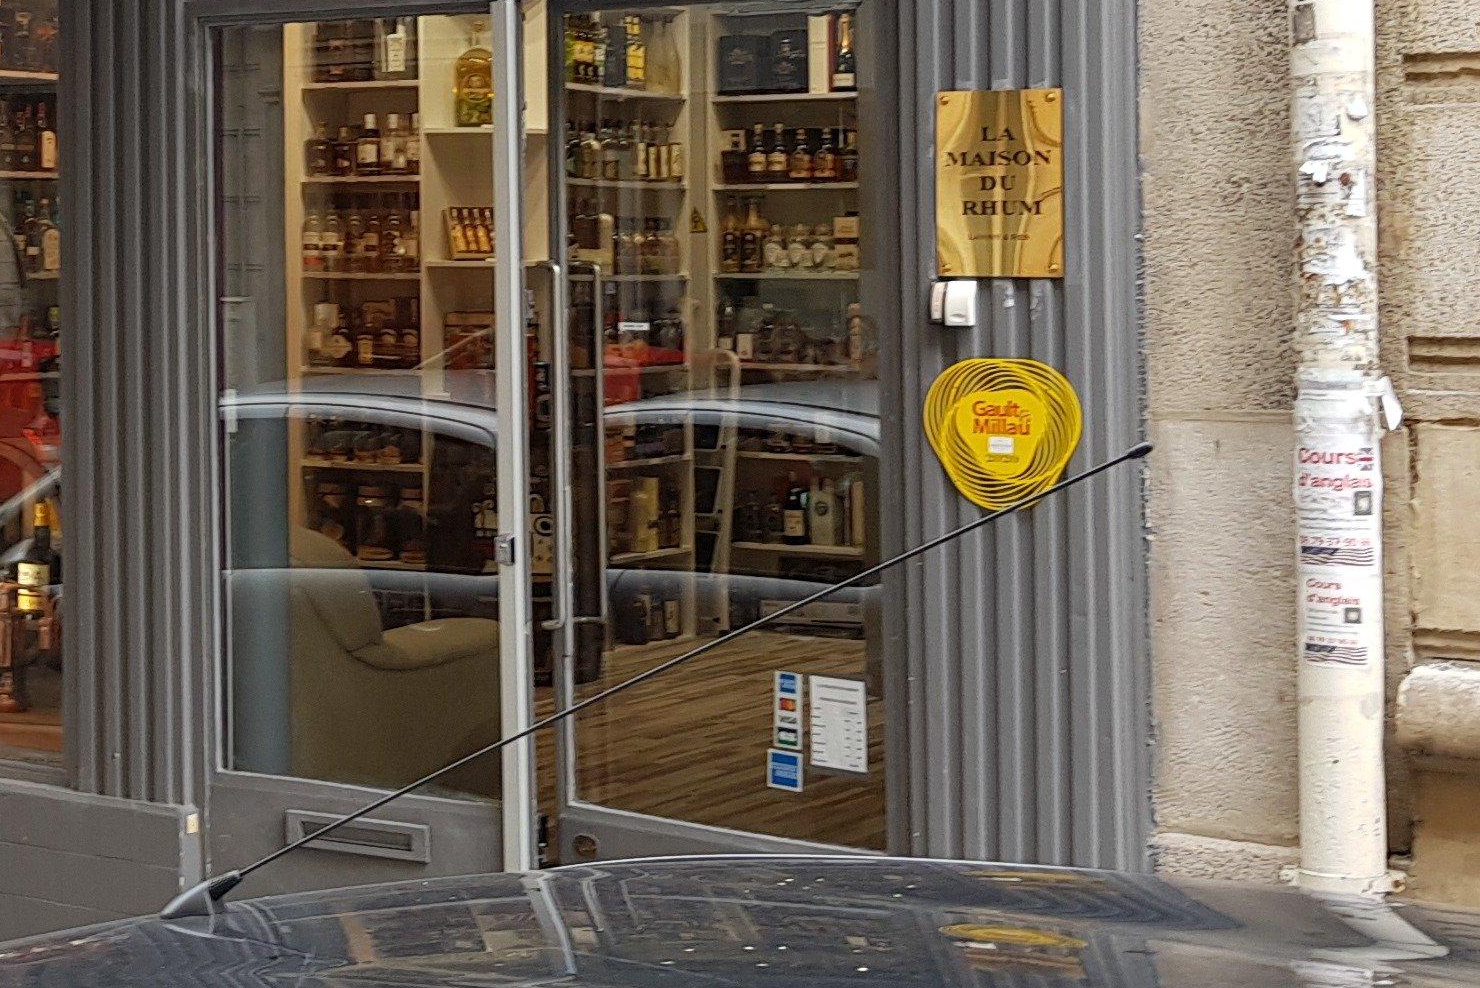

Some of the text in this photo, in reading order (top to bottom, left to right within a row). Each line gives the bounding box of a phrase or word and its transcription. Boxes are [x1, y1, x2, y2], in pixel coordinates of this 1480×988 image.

[981, 126, 1015, 142] LA
[944, 150, 1052, 166] MAISON
[979, 175, 1016, 191] DU
[961, 199, 1043, 216] RHUM
[972, 418, 1031, 435] Millau
[1299, 447, 1356, 465] Cours
